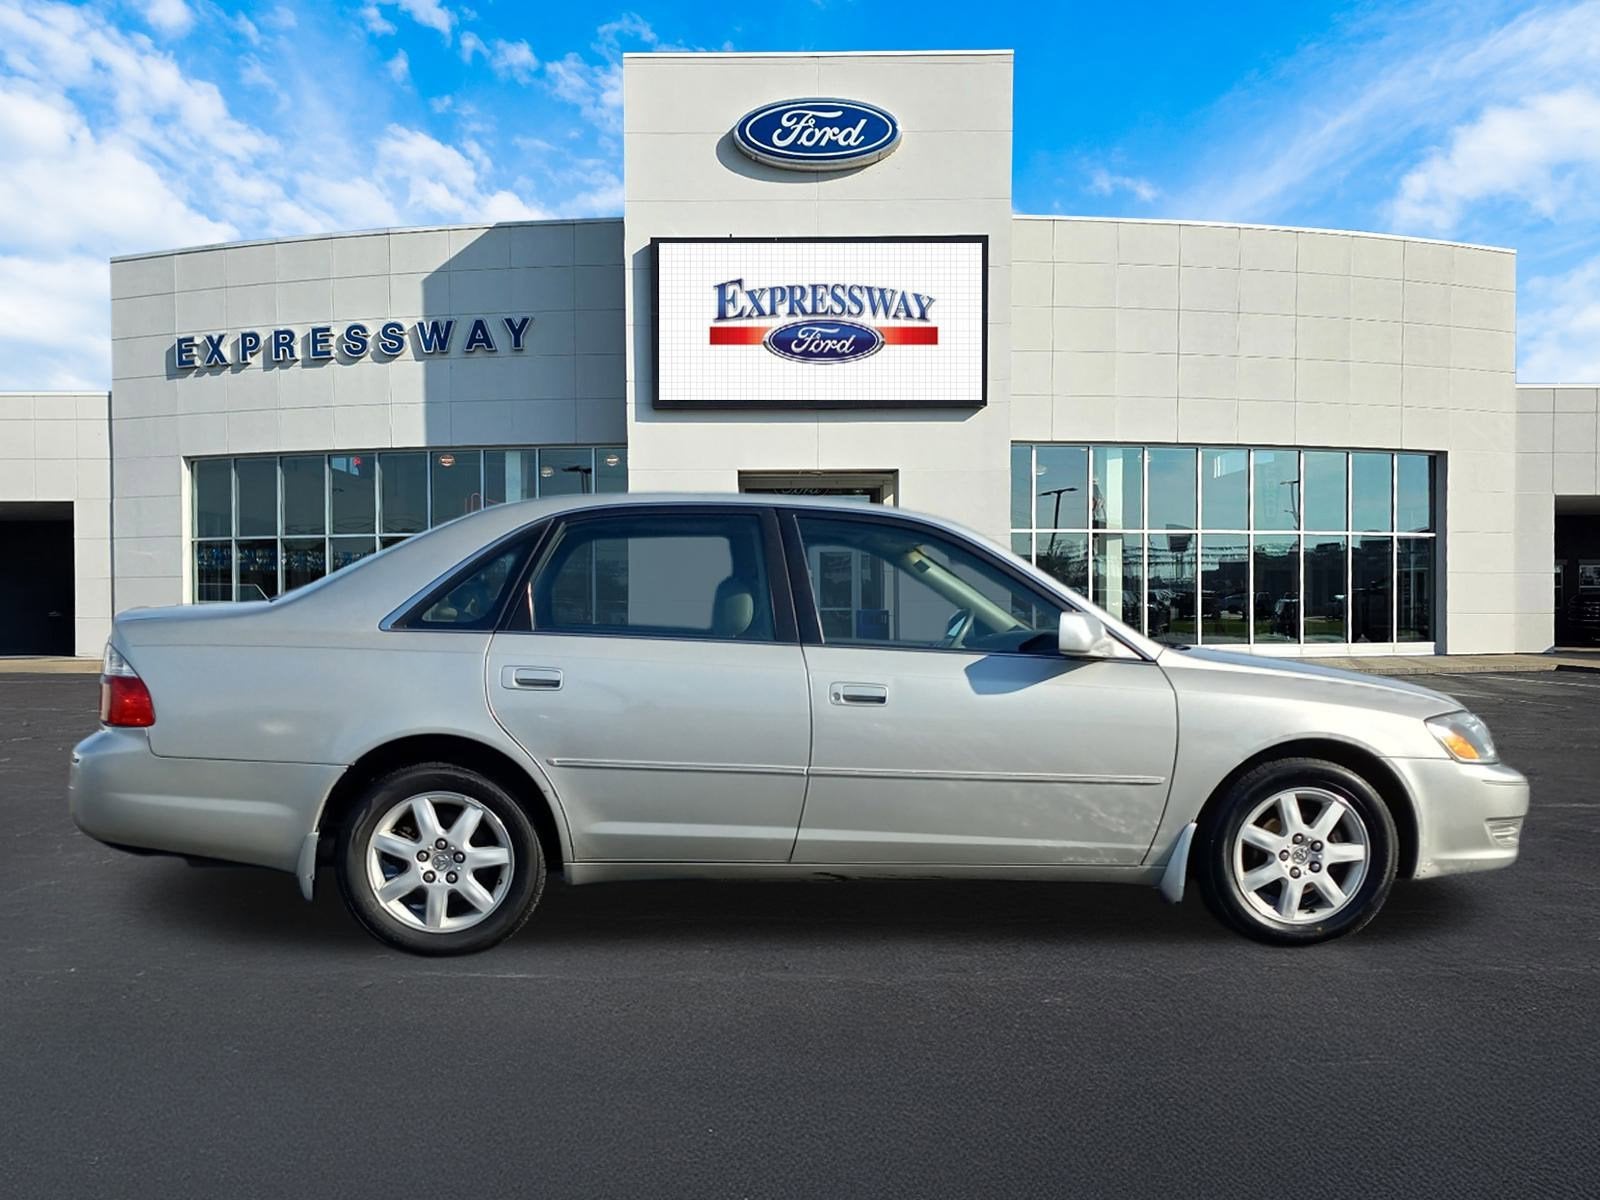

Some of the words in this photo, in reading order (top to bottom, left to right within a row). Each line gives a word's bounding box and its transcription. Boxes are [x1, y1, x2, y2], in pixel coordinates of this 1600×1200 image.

[771, 110, 867, 147] Ford
[713, 278, 934, 322] EXPRESSWAY
[175, 315, 533, 369] EXPRESSWAY
[791, 328, 855, 353] Ford
